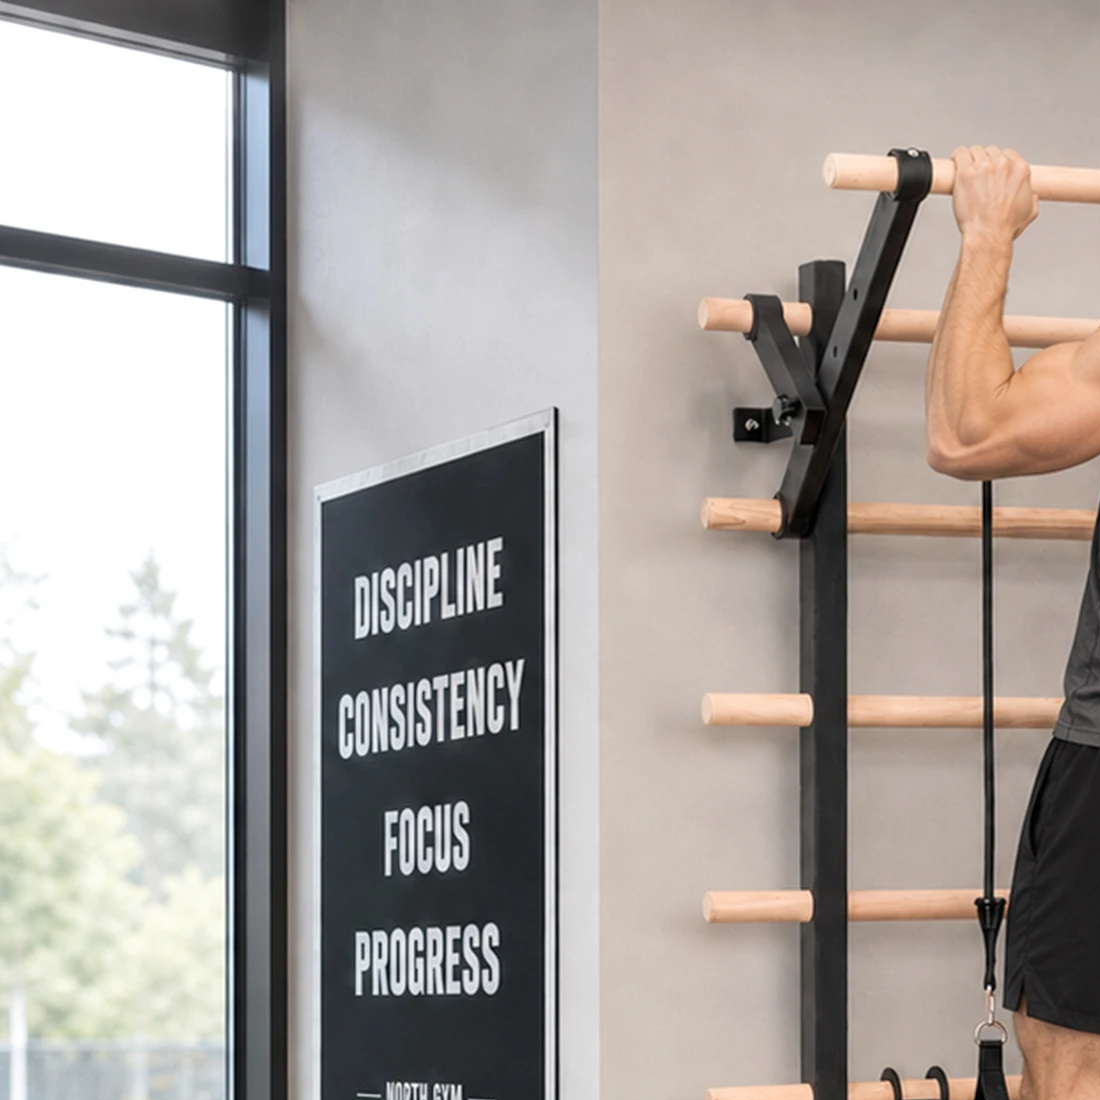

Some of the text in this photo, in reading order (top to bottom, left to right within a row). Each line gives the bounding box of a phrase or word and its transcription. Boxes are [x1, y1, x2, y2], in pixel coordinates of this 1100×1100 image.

[354, 536, 503, 640] DISCIPLINE
[338, 658, 525, 760] CONSISTENCY
[384, 800, 470, 877] FOCUS
[354, 922, 500, 997] PROGRESS
